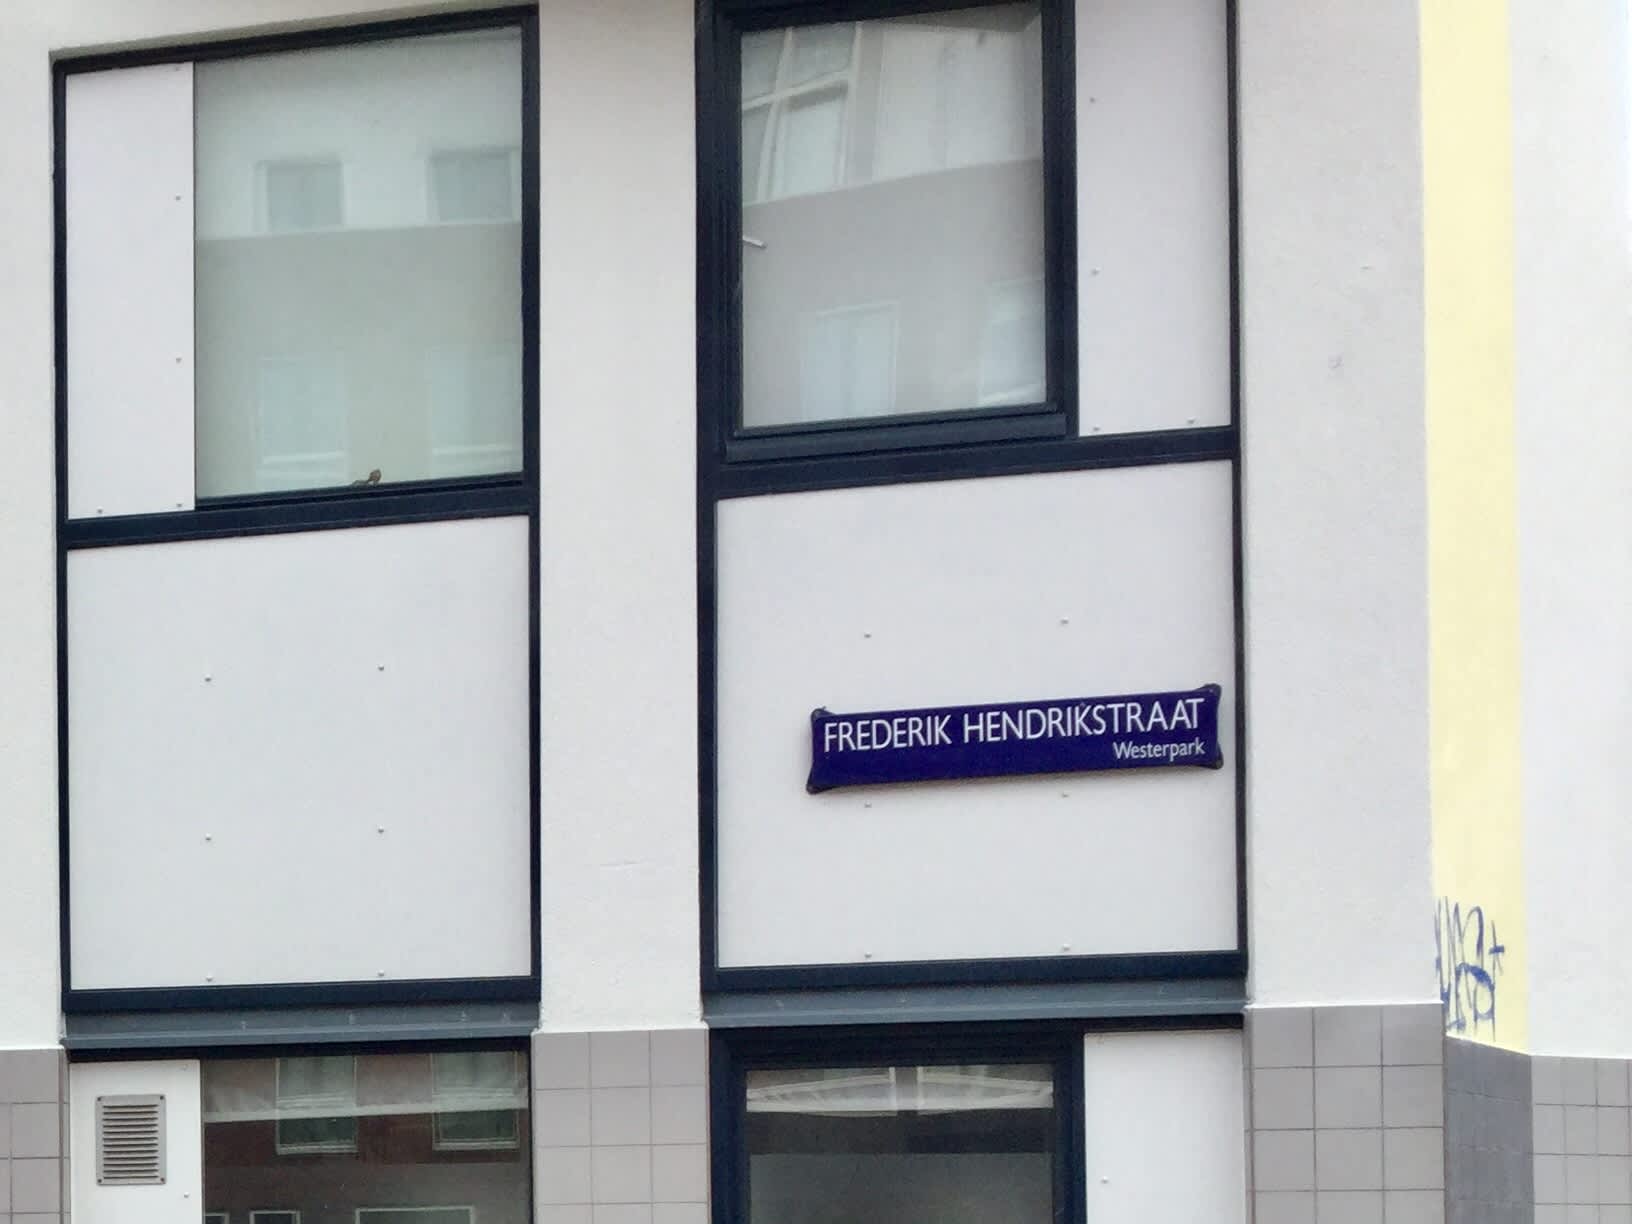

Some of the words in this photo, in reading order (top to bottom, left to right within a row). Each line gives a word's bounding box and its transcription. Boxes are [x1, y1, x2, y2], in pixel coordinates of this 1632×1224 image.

[824, 714, 952, 752] FREDERIK
[964, 698, 1205, 744] HENDRIKSTRAAT
[1113, 738, 1205, 762] Westerpark
